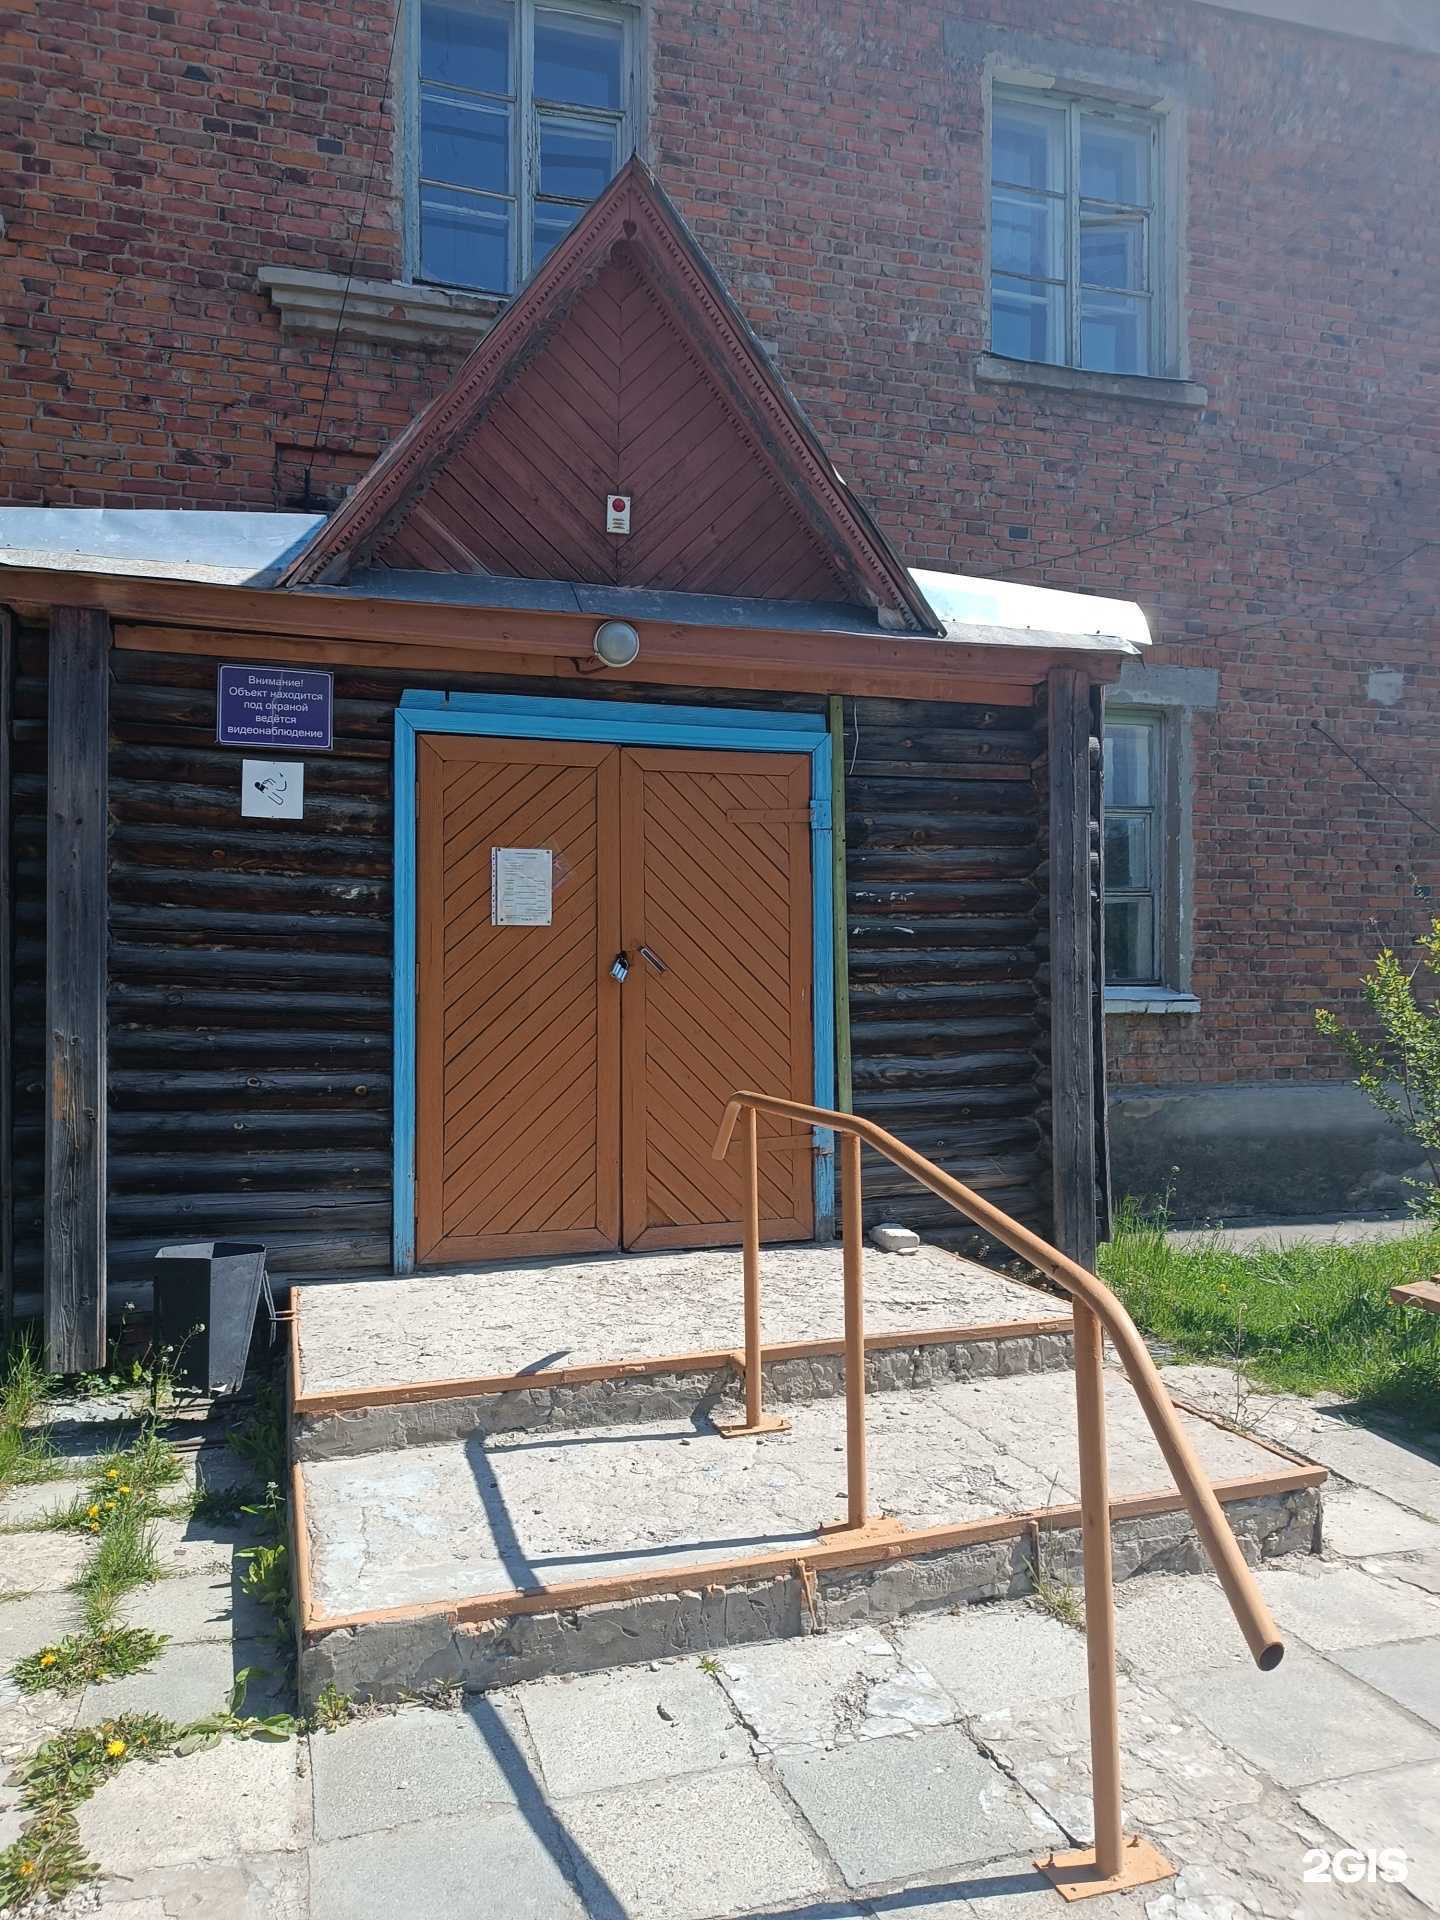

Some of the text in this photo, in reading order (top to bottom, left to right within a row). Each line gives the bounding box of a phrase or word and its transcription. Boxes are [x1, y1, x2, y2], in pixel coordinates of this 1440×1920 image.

[248, 675, 304, 688] Внимание!
[228, 686, 323, 701] Объект находится
[243, 701, 309, 712] под охраной
[227, 725, 323, 738] видеонаблюдение
